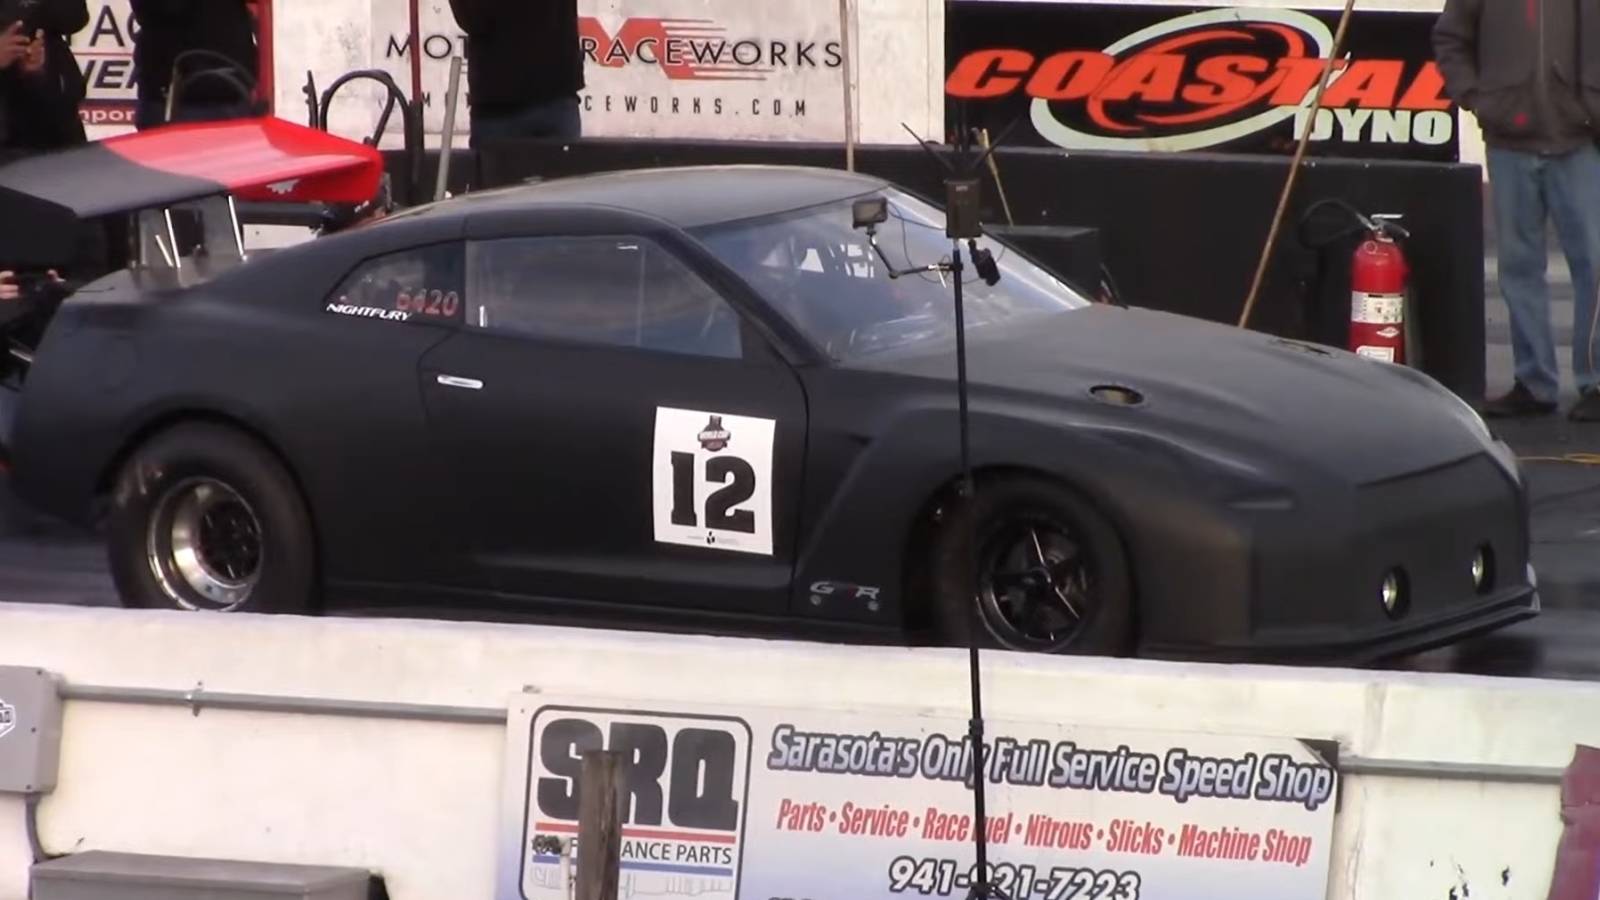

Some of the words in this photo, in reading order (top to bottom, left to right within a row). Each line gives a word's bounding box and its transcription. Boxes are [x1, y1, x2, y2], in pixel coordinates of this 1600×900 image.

[582, 38, 843, 67] RACEWORKS
[945, 49, 1452, 109] COASTAL
[1293, 107, 1453, 145] DYNO
[326, 303, 411, 321] NIGHTFURY
[670, 450, 755, 534] 12
[537, 718, 739, 831] SRQ
[767, 724, 920, 777] Sarasota's
[989, 737, 1050, 786] Full
[1049, 741, 1160, 793] Service
[1159, 748, 1256, 802] Speed
[1254, 754, 1337, 811] Shop
[676, 847, 733, 865] PARTS
[776, 799, 826, 833] Parts
[839, 801, 909, 838] Service
[922, 807, 970, 842] Race
[971, 811, 1014, 844] uel
[1023, 813, 1094, 850] Nitrous
[1106, 819, 1165, 855] Slicks
[1177, 824, 1261, 861] Machine
[1262, 828, 1313, 867] Shop
